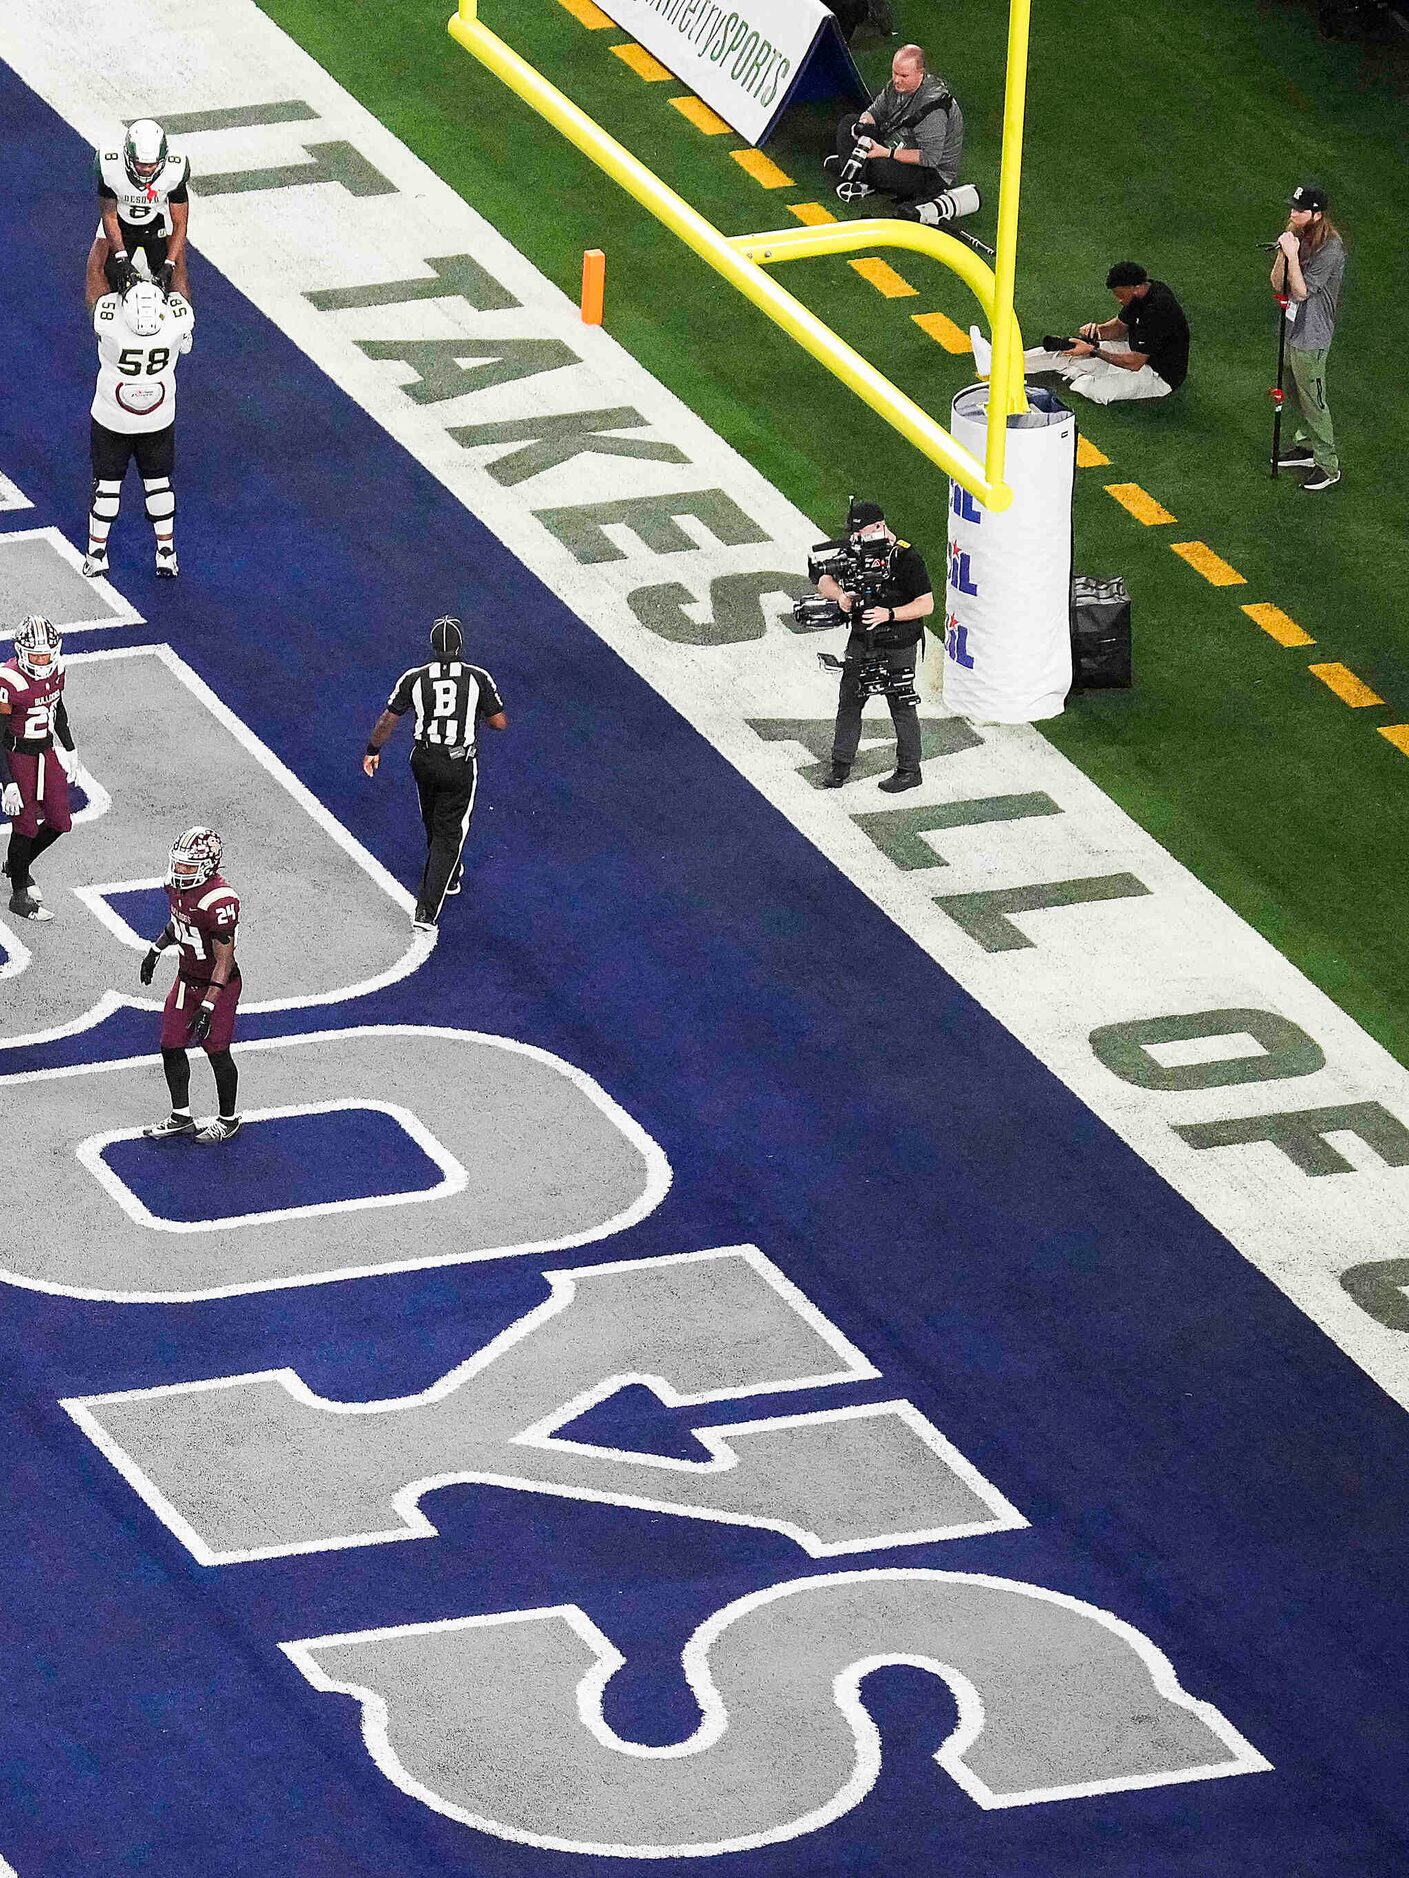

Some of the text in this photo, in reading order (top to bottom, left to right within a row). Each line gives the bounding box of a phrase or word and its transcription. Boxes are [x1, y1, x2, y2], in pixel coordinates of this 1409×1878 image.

[100, 301, 115, 321] 58
[169, 299, 187, 318] 58
[117, 348, 170, 376] 58
[120, 98, 1409, 1178] IT TAKES ALL OF
[433, 680, 458, 717] B
[215, 903, 237, 925] 24
